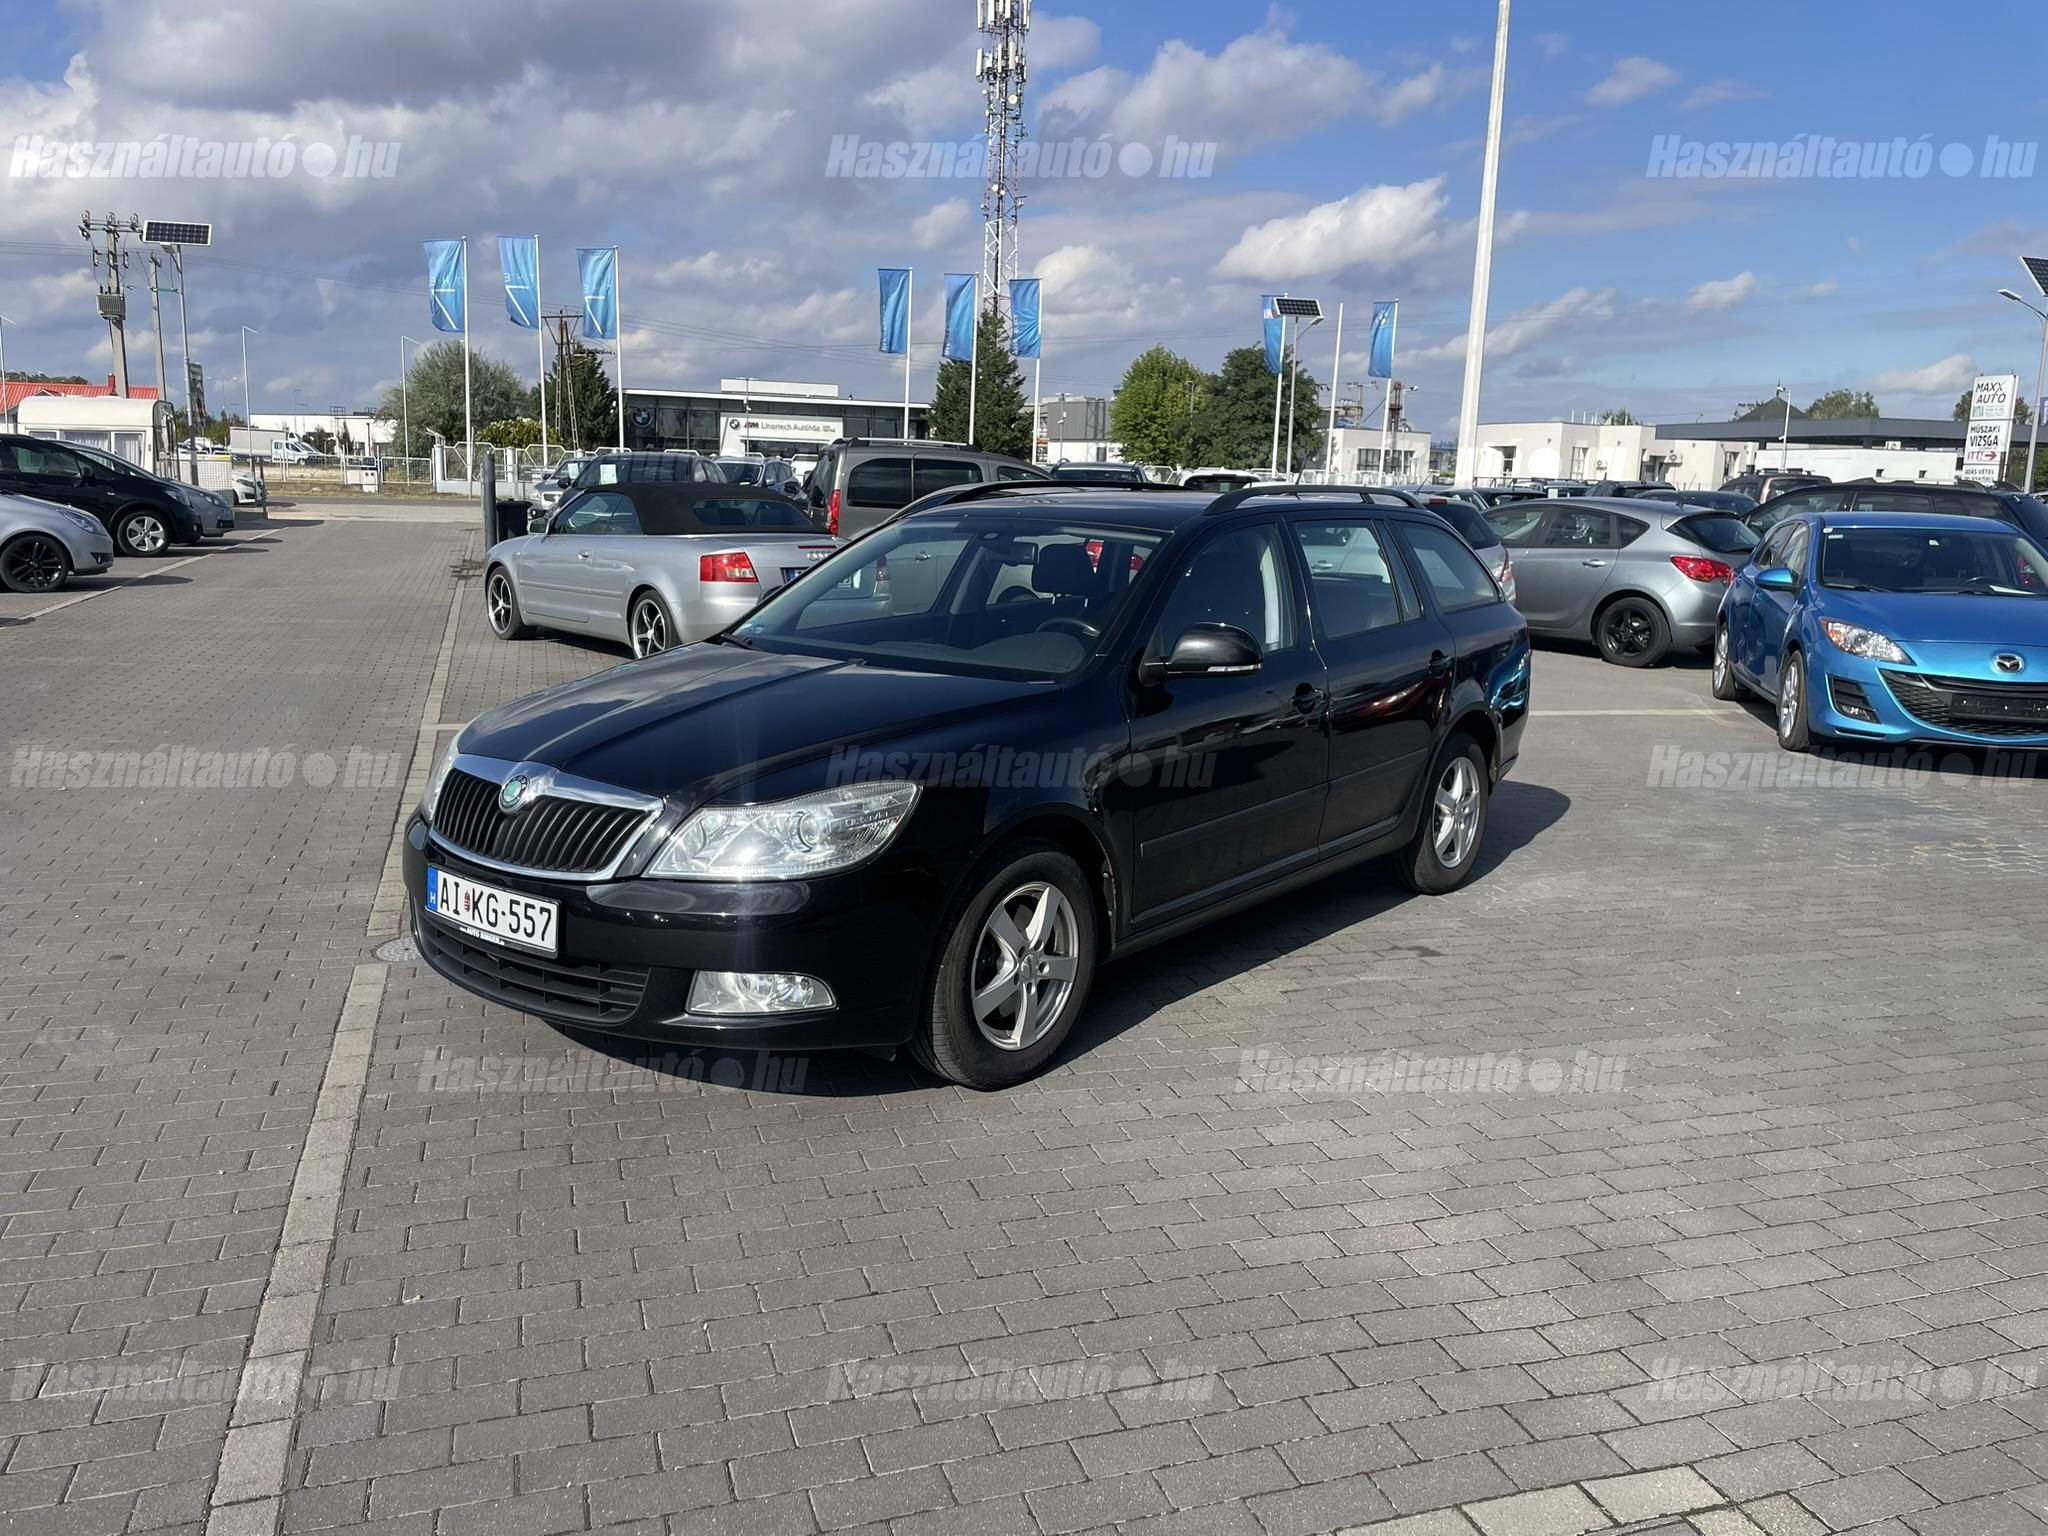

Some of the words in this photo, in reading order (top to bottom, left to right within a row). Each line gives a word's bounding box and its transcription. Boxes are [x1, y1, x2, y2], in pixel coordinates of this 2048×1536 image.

[1975, 381, 2004, 393] MAXX
[1970, 435, 1998, 447] VIZSGA
[440, 877, 460, 916] AI
[471, 887, 552, 942] KG-557
